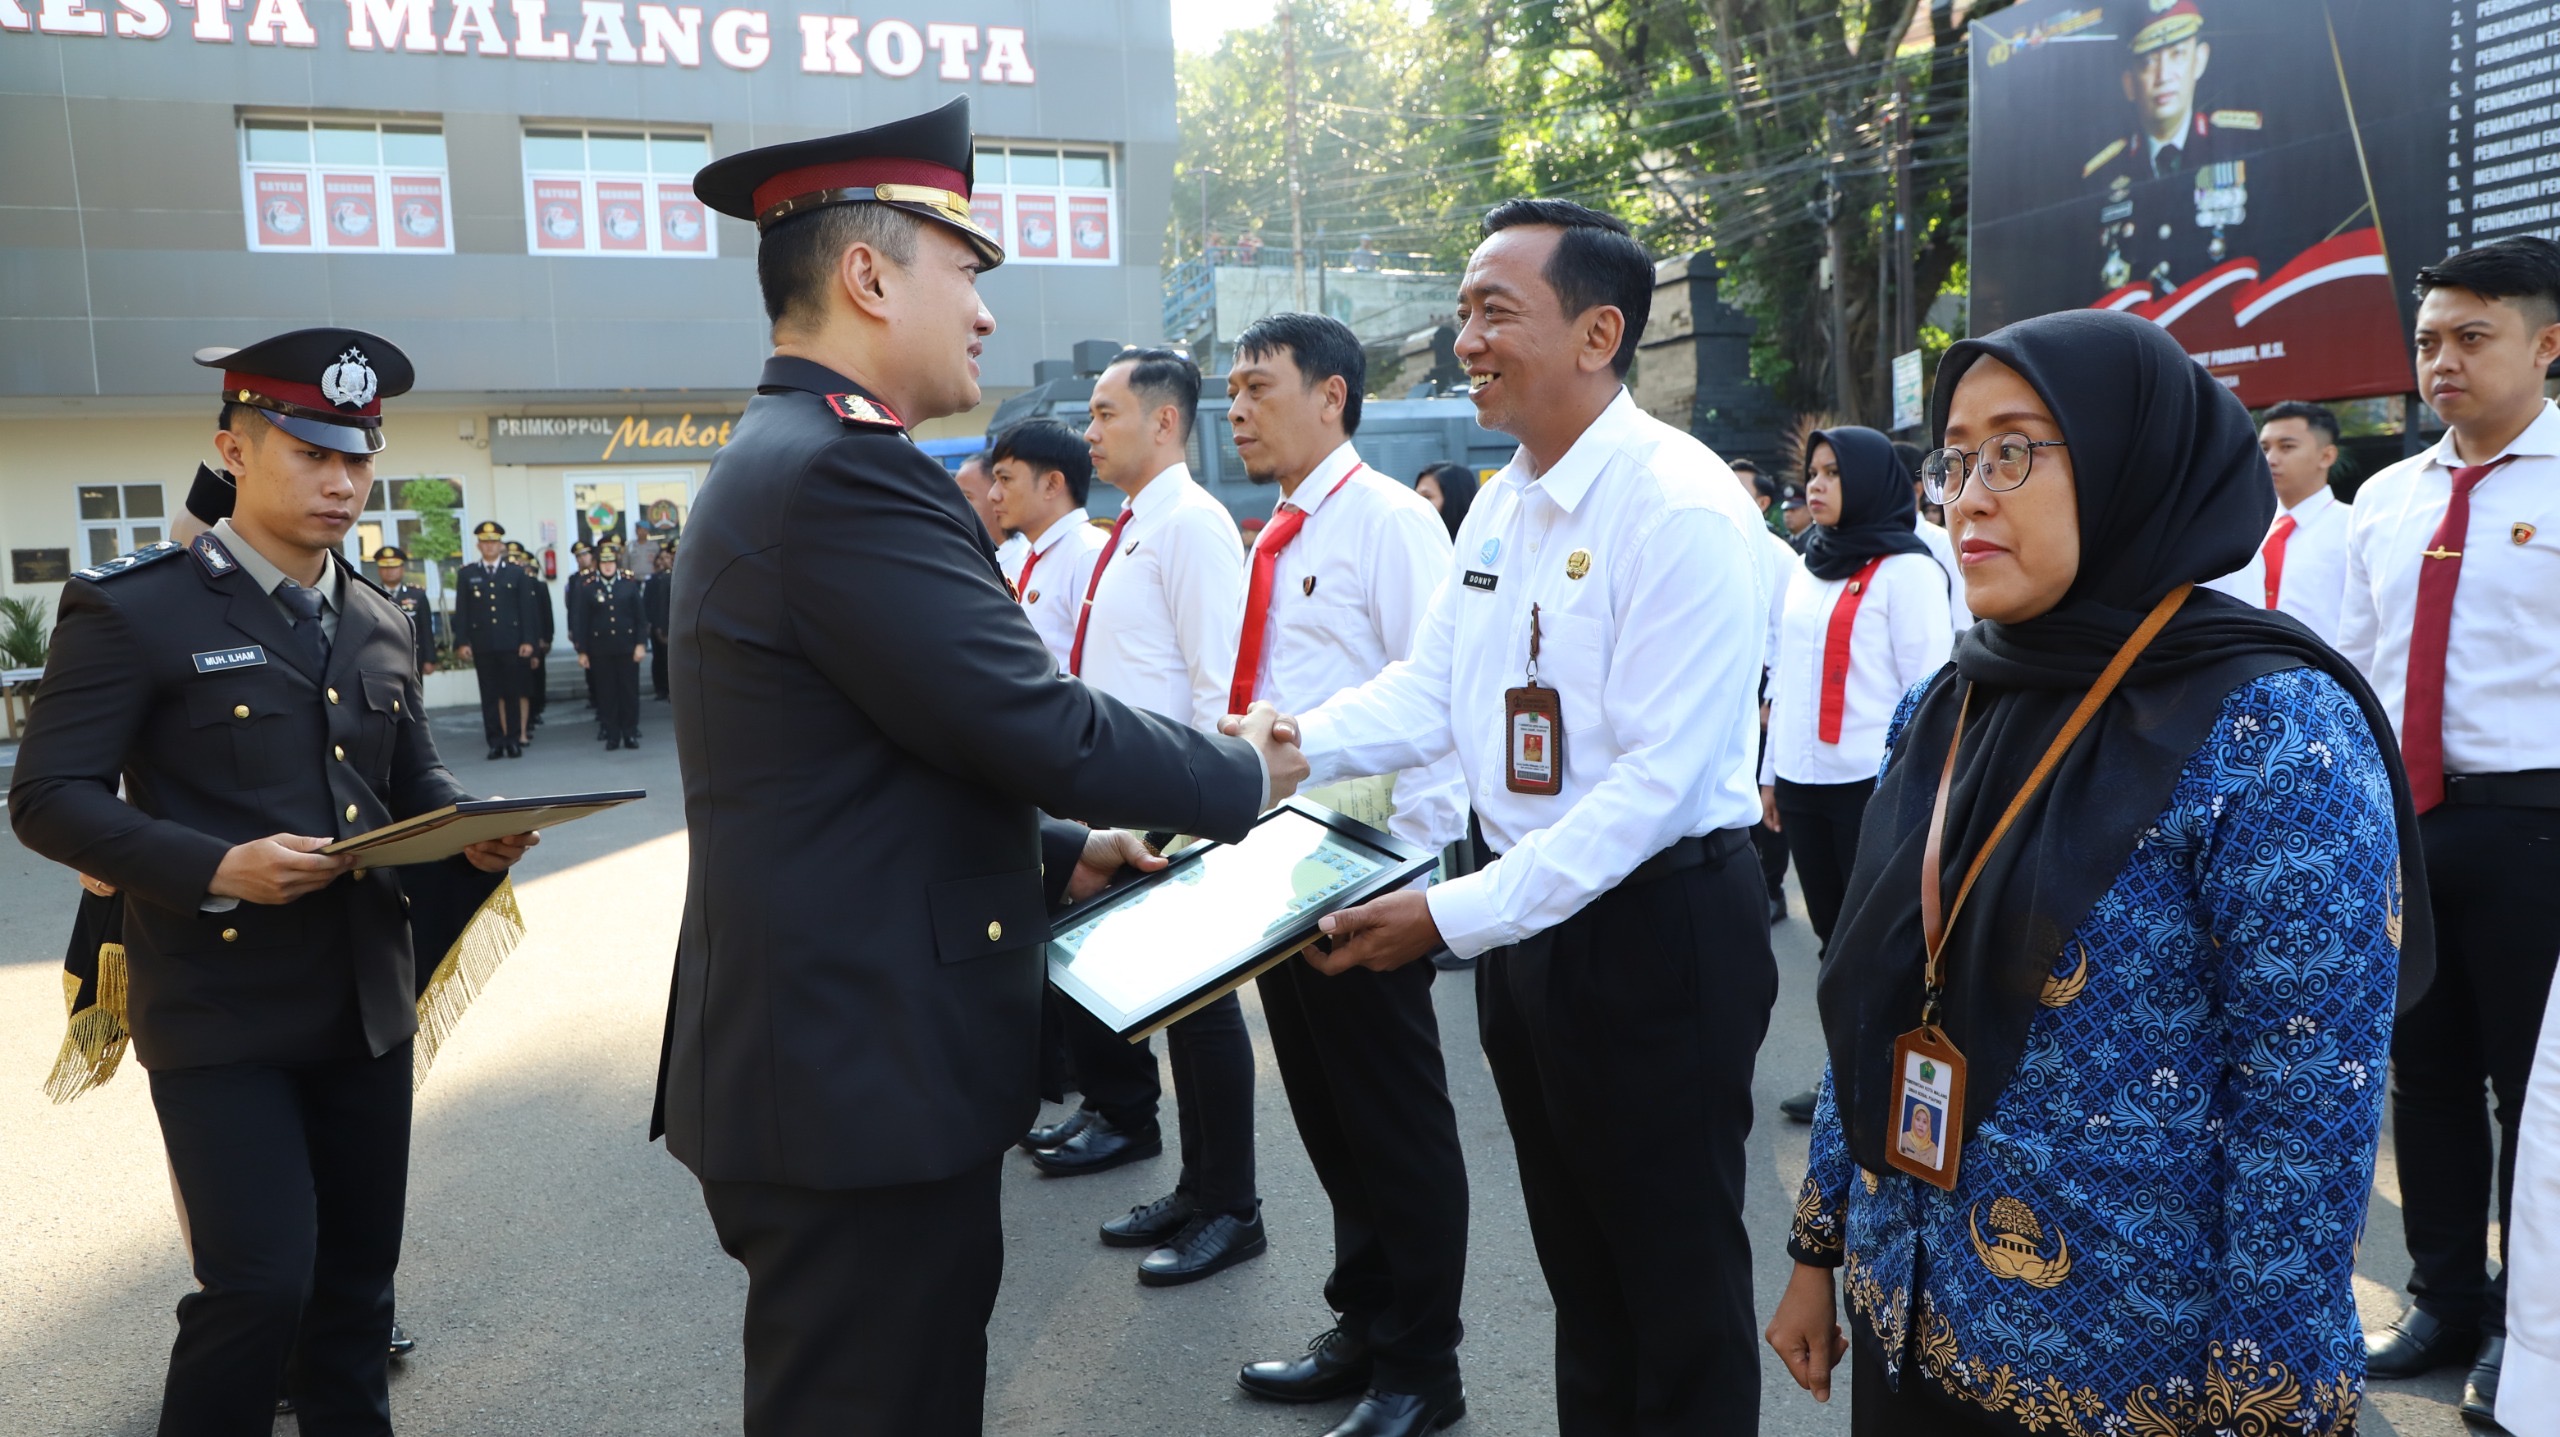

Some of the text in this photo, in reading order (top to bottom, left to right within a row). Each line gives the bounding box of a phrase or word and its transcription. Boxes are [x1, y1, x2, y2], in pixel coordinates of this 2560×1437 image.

[347, 0, 771, 70] MALANG
[800, 14, 1036, 84] KOTA
[2475, 7, 2551, 43] MENJADIKAN
[2475, 33, 2546, 67] PERUBAHAN
[2474, 55, 2553, 91] PEMANTAPAN
[2474, 80, 2554, 115] PENINGKATAN
[2473, 104, 2552, 139] PEMANTAPAN
[2473, 131, 2542, 163] PEMULIHAN
[2472, 157, 2534, 187] MENJAMIN
[2472, 181, 2540, 210] PENGUATAN
[2472, 203, 2552, 234] PENINGKATAN
[497, 413, 731, 461] PRIMKOPPOL Makot
[1469, 574, 1492, 586] DONNY
[204, 651, 256, 666] MUH. ILHAM
